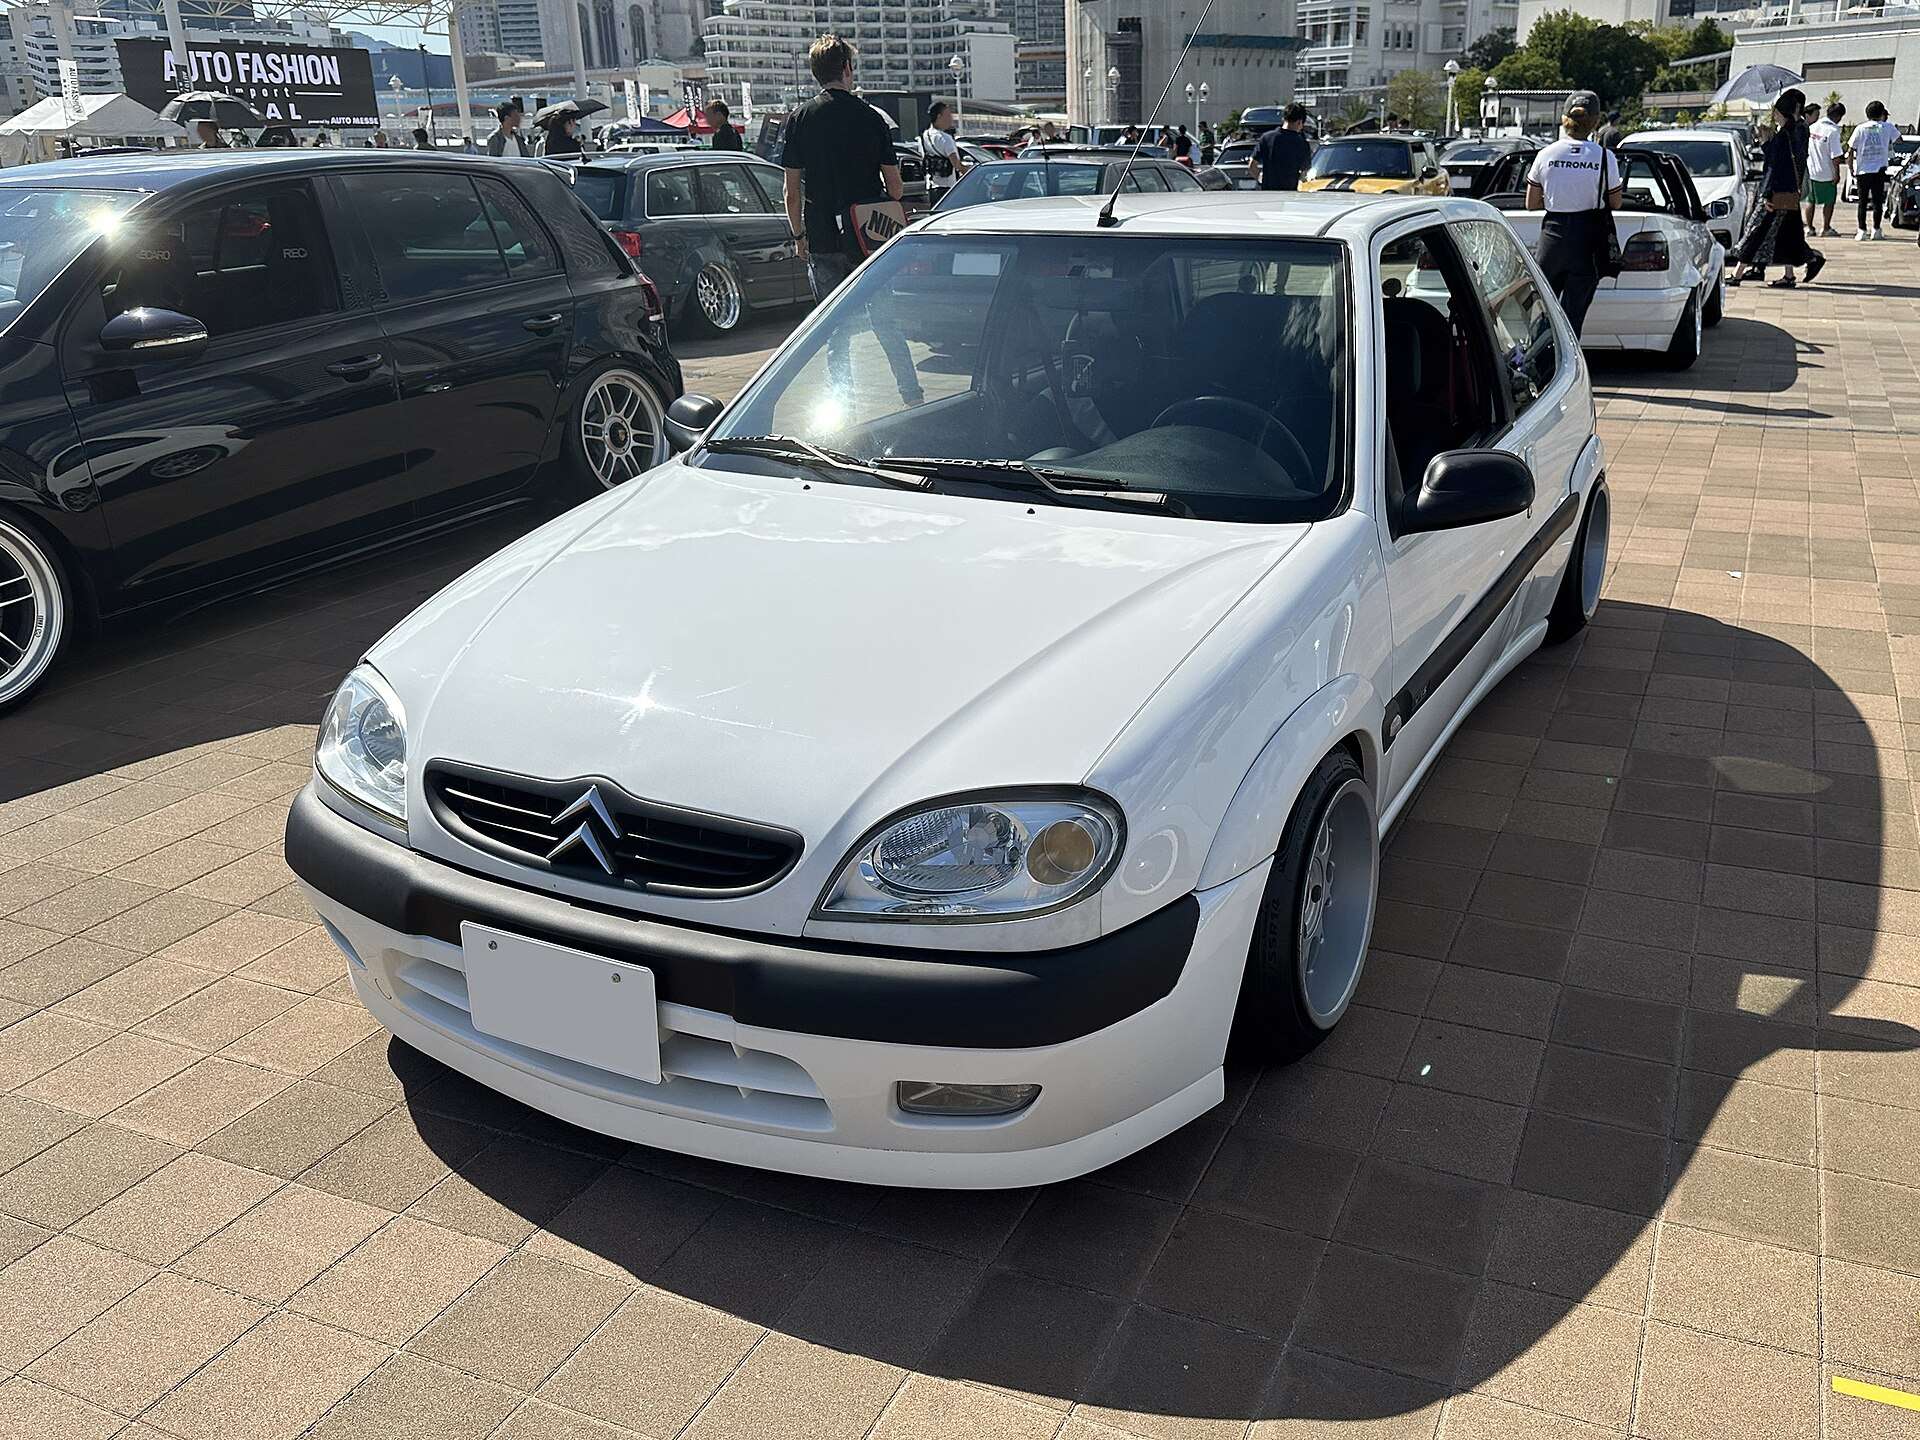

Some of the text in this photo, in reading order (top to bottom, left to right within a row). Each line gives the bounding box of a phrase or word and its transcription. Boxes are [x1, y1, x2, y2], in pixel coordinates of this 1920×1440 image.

[163, 49, 342, 85] AUTO FASHION
[224, 85, 291, 99] import
[330, 116, 352, 125] AUTO
[352, 117, 379, 125] MESSE
[1548, 160, 1600, 171] PETRONAS
